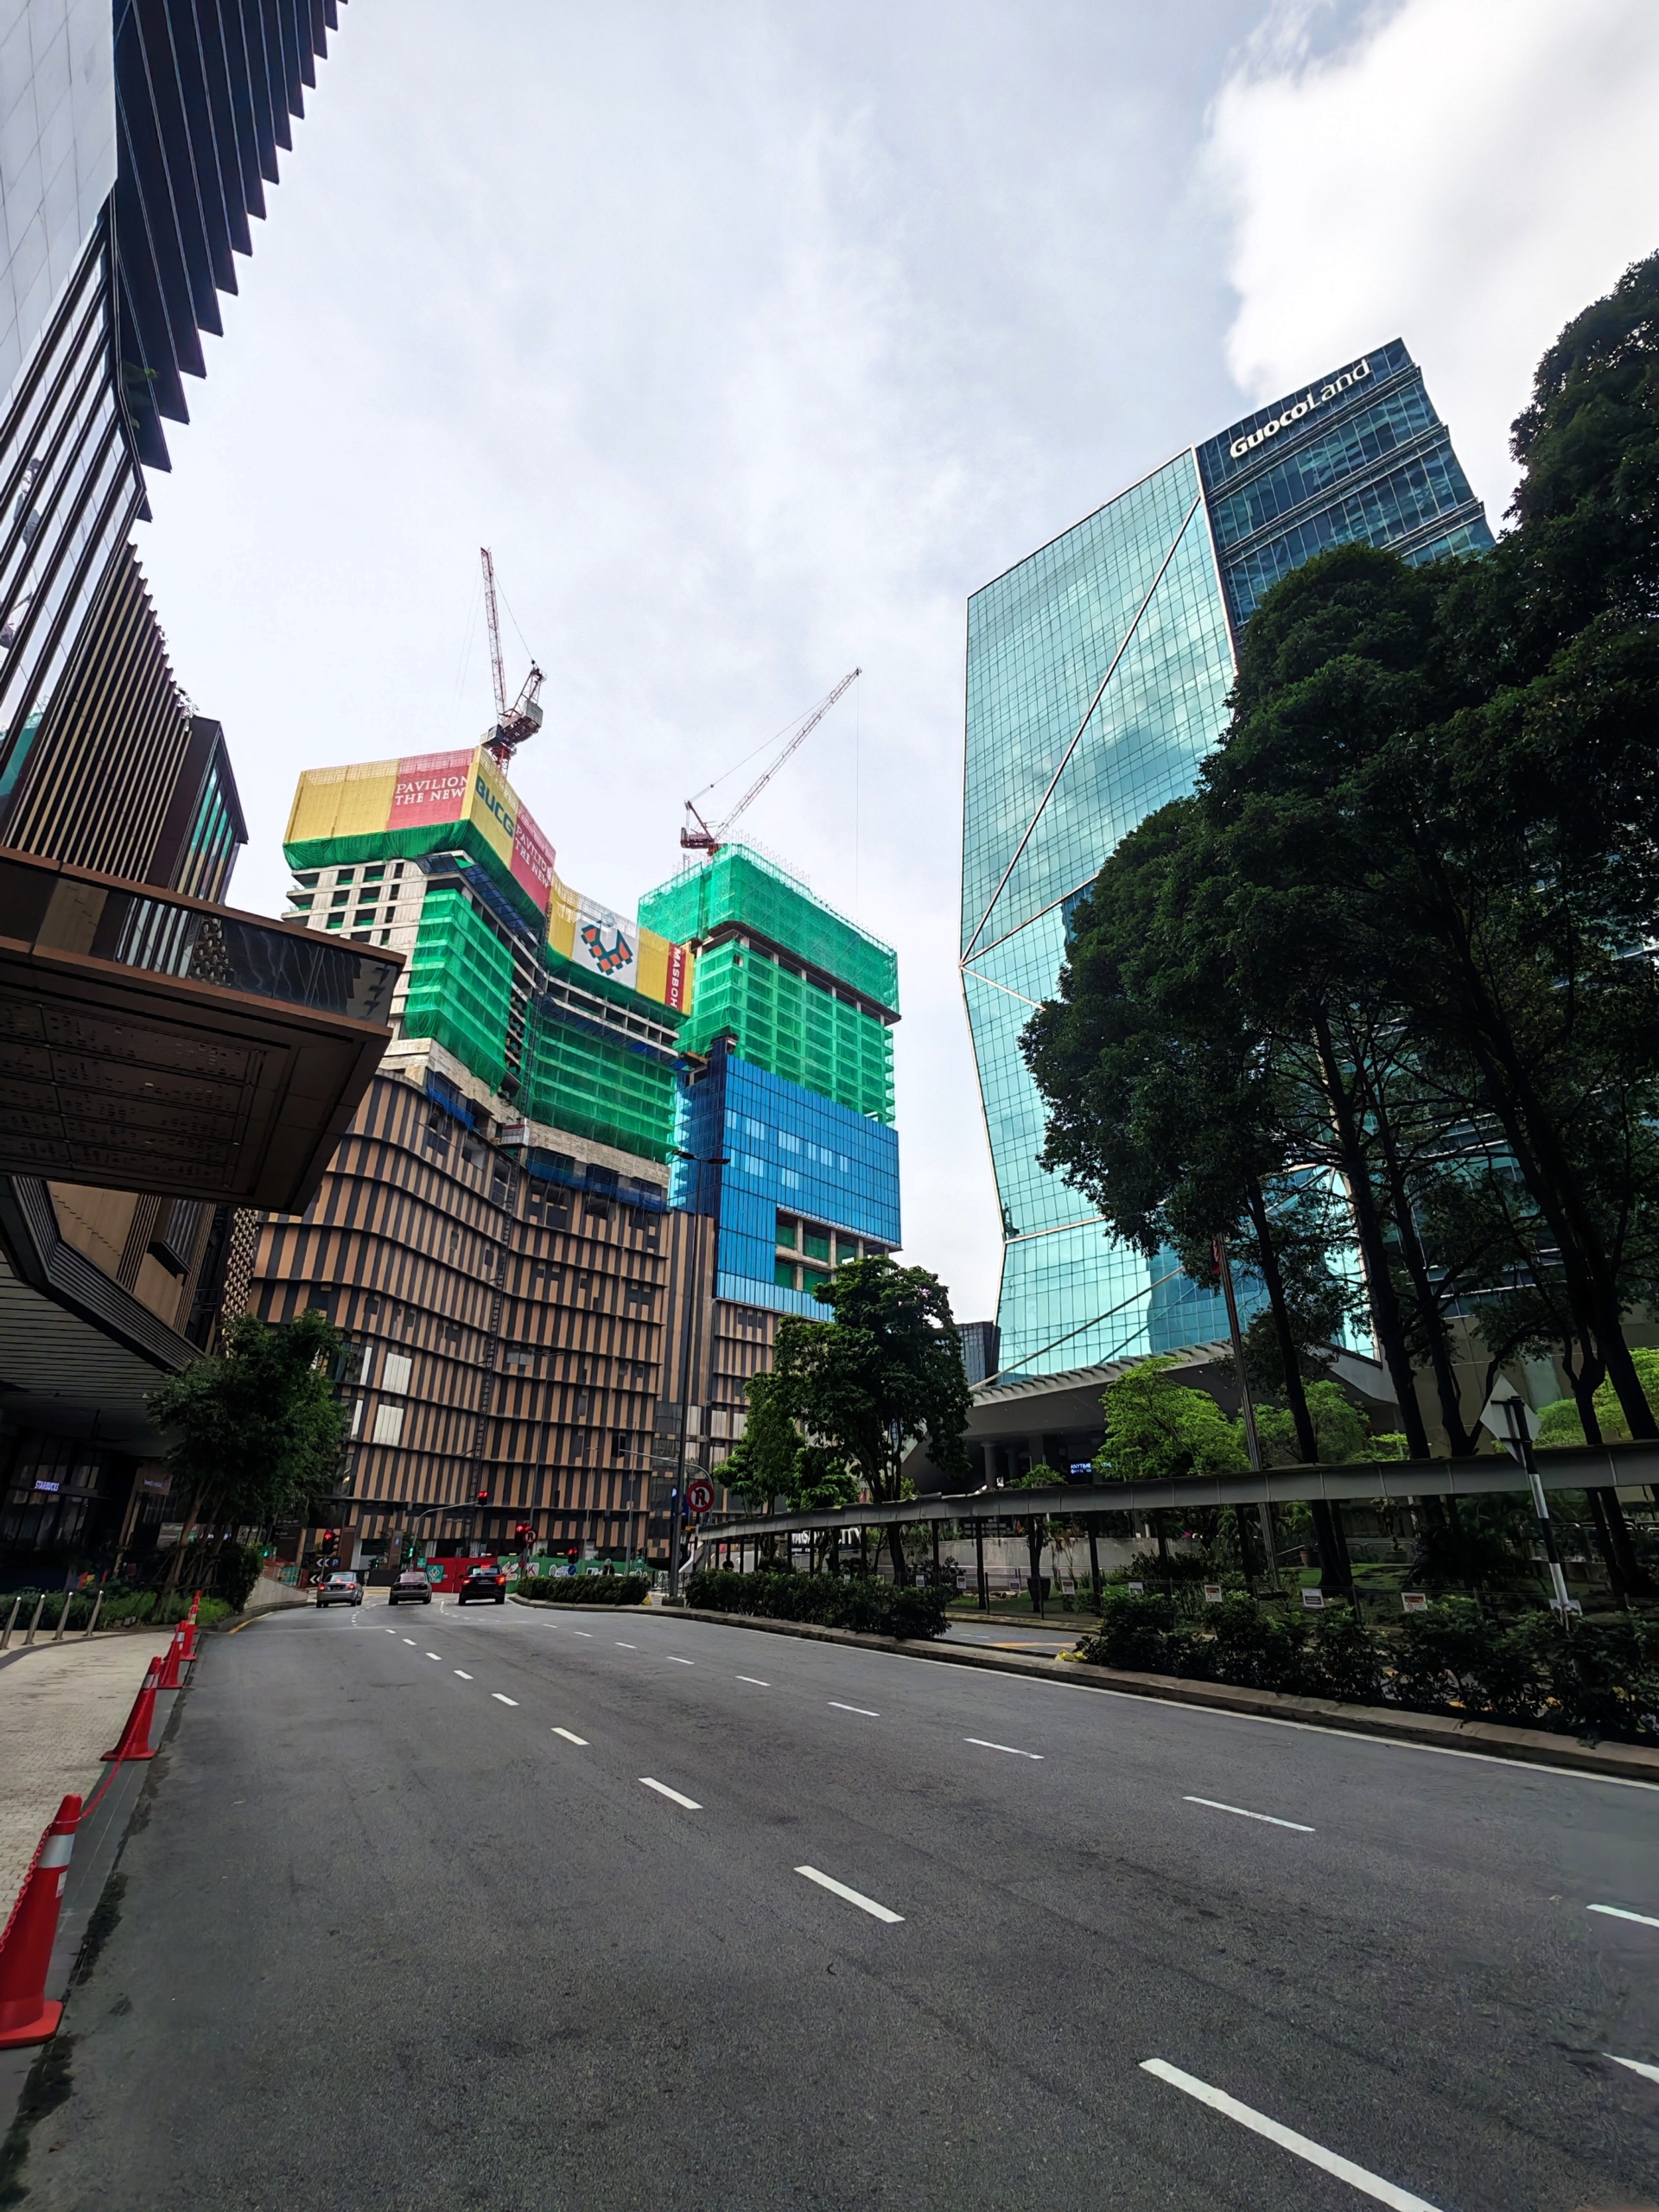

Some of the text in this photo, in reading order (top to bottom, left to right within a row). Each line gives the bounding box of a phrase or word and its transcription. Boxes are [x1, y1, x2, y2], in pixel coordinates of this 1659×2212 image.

[1230, 359, 1371, 459] GuocoLand
[395, 786, 467, 806] THE NEW
[396, 775, 468, 794] PAVILION
[475, 775, 517, 839] BUCG
[515, 836, 551, 889] THE NEW
[670, 947, 682, 1008] MASBOH
